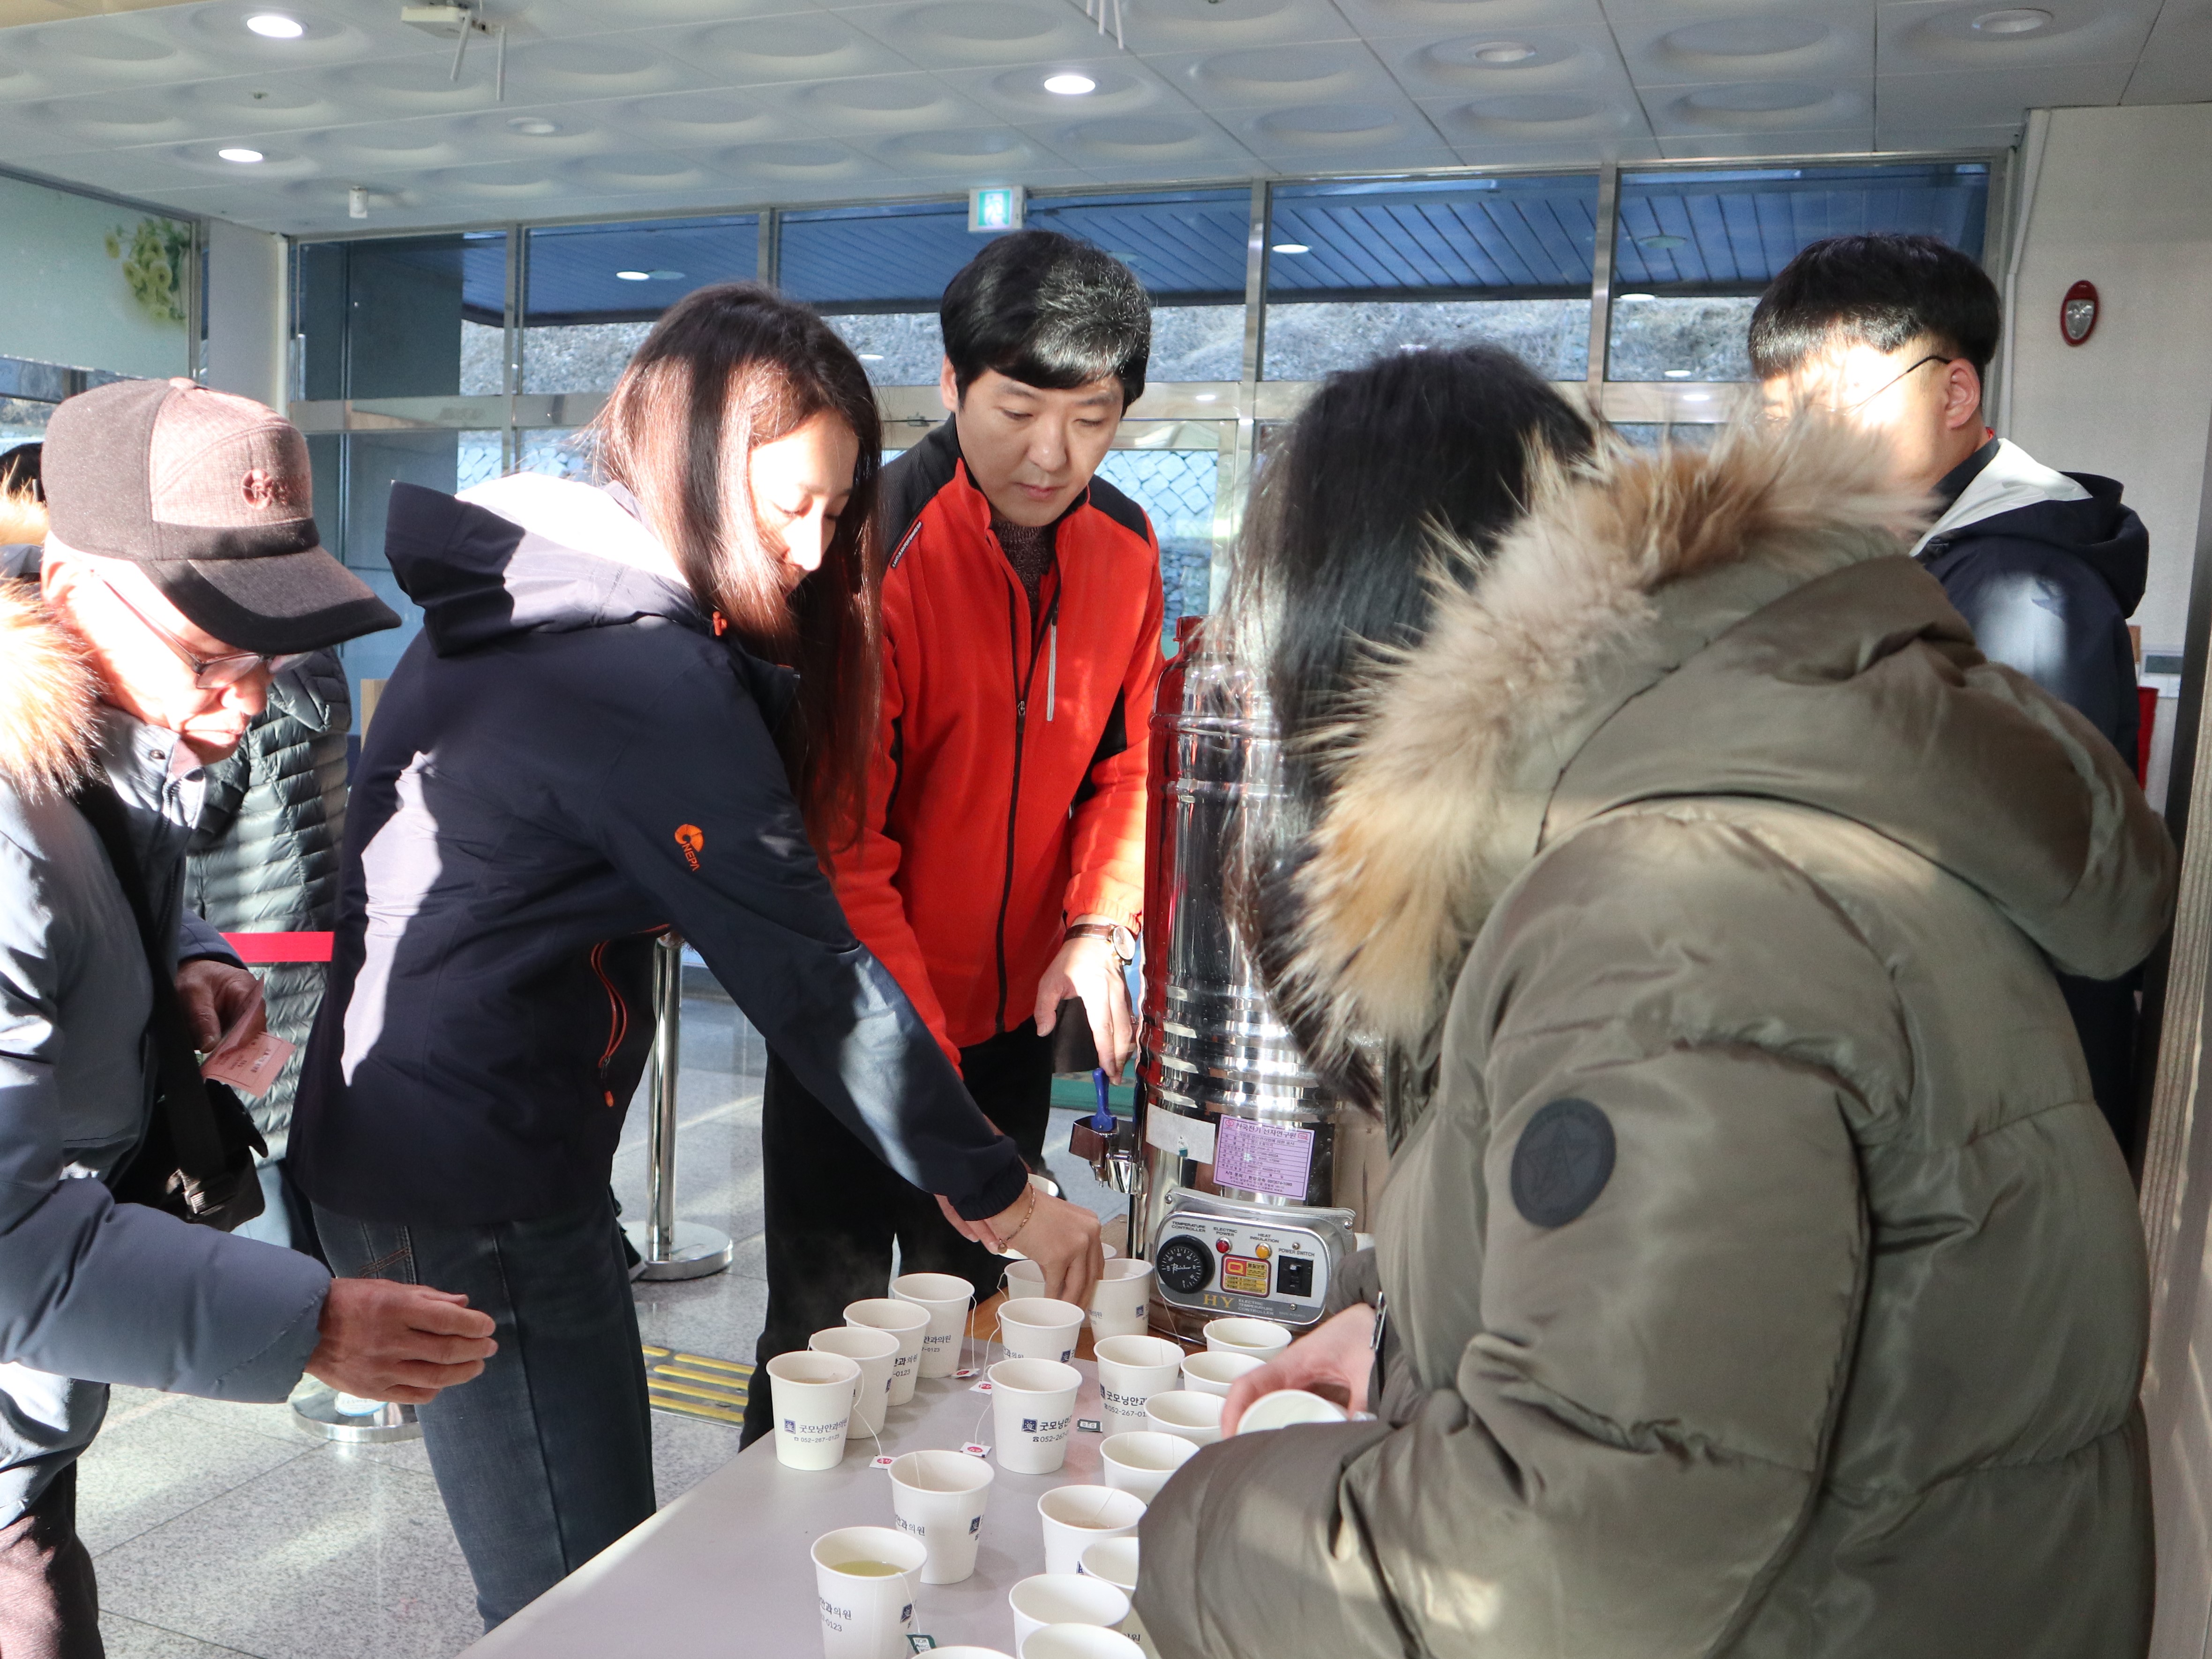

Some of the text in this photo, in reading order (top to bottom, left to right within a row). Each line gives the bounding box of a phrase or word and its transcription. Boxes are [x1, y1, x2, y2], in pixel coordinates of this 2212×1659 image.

[682, 843, 700, 871] NEPA
[1203, 1294, 1234, 1308] HY
[1238, 1303, 1274, 1311] TEMPERATURE
[1238, 1306, 1274, 1315] CONTROLLER
